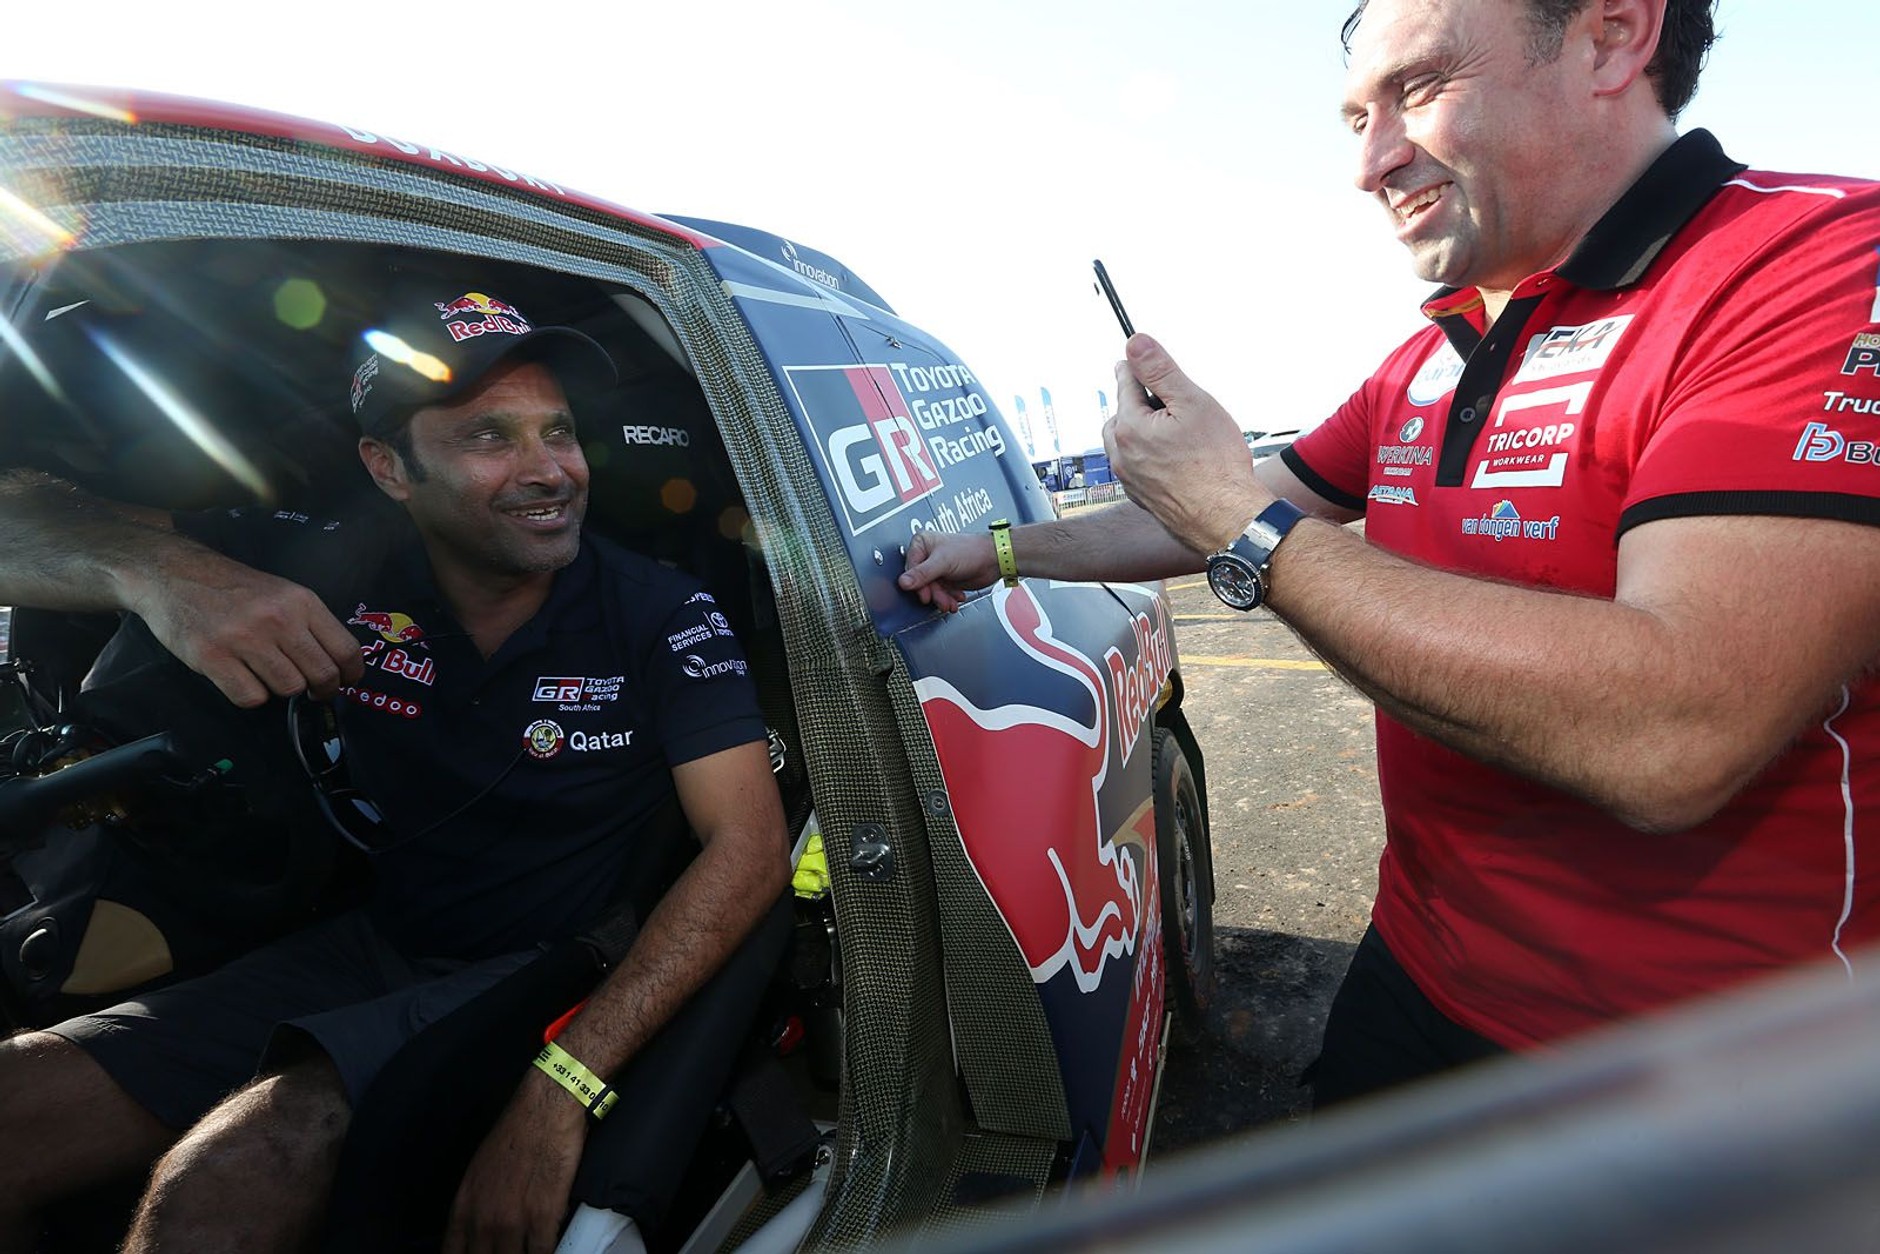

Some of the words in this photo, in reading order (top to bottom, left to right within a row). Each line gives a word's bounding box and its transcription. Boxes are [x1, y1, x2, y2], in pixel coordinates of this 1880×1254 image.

[793, 258, 840, 290] innovation
[446, 314, 502, 342] Red
[890, 363, 977, 393] TOYOTA
[912, 392, 988, 431] GAZOO
[622, 425, 689, 447] RECARO
[929, 424, 1006, 469] Racing
[1487, 423, 1575, 453] TRICORP
[828, 416, 936, 514] GR
[1492, 454, 1545, 467] WORKWEAR
[954, 488, 993, 527] Africa
[1462, 518, 1478, 534] van
[1523, 516, 1560, 540] verf
[668, 623, 709, 644] FINANCIAL
[671, 631, 712, 652] SERVICES
[536, 686, 579, 700] GR
[585, 684, 620, 694] GAZOO
[586, 676, 625, 686] TOYOTA
[1104, 616, 1150, 769] Red
[558, 704, 581, 712] South
[570, 731, 634, 752] Qatar
[553, 1062, 567, 1076] +33
[579, 1083, 590, 1096] 33
